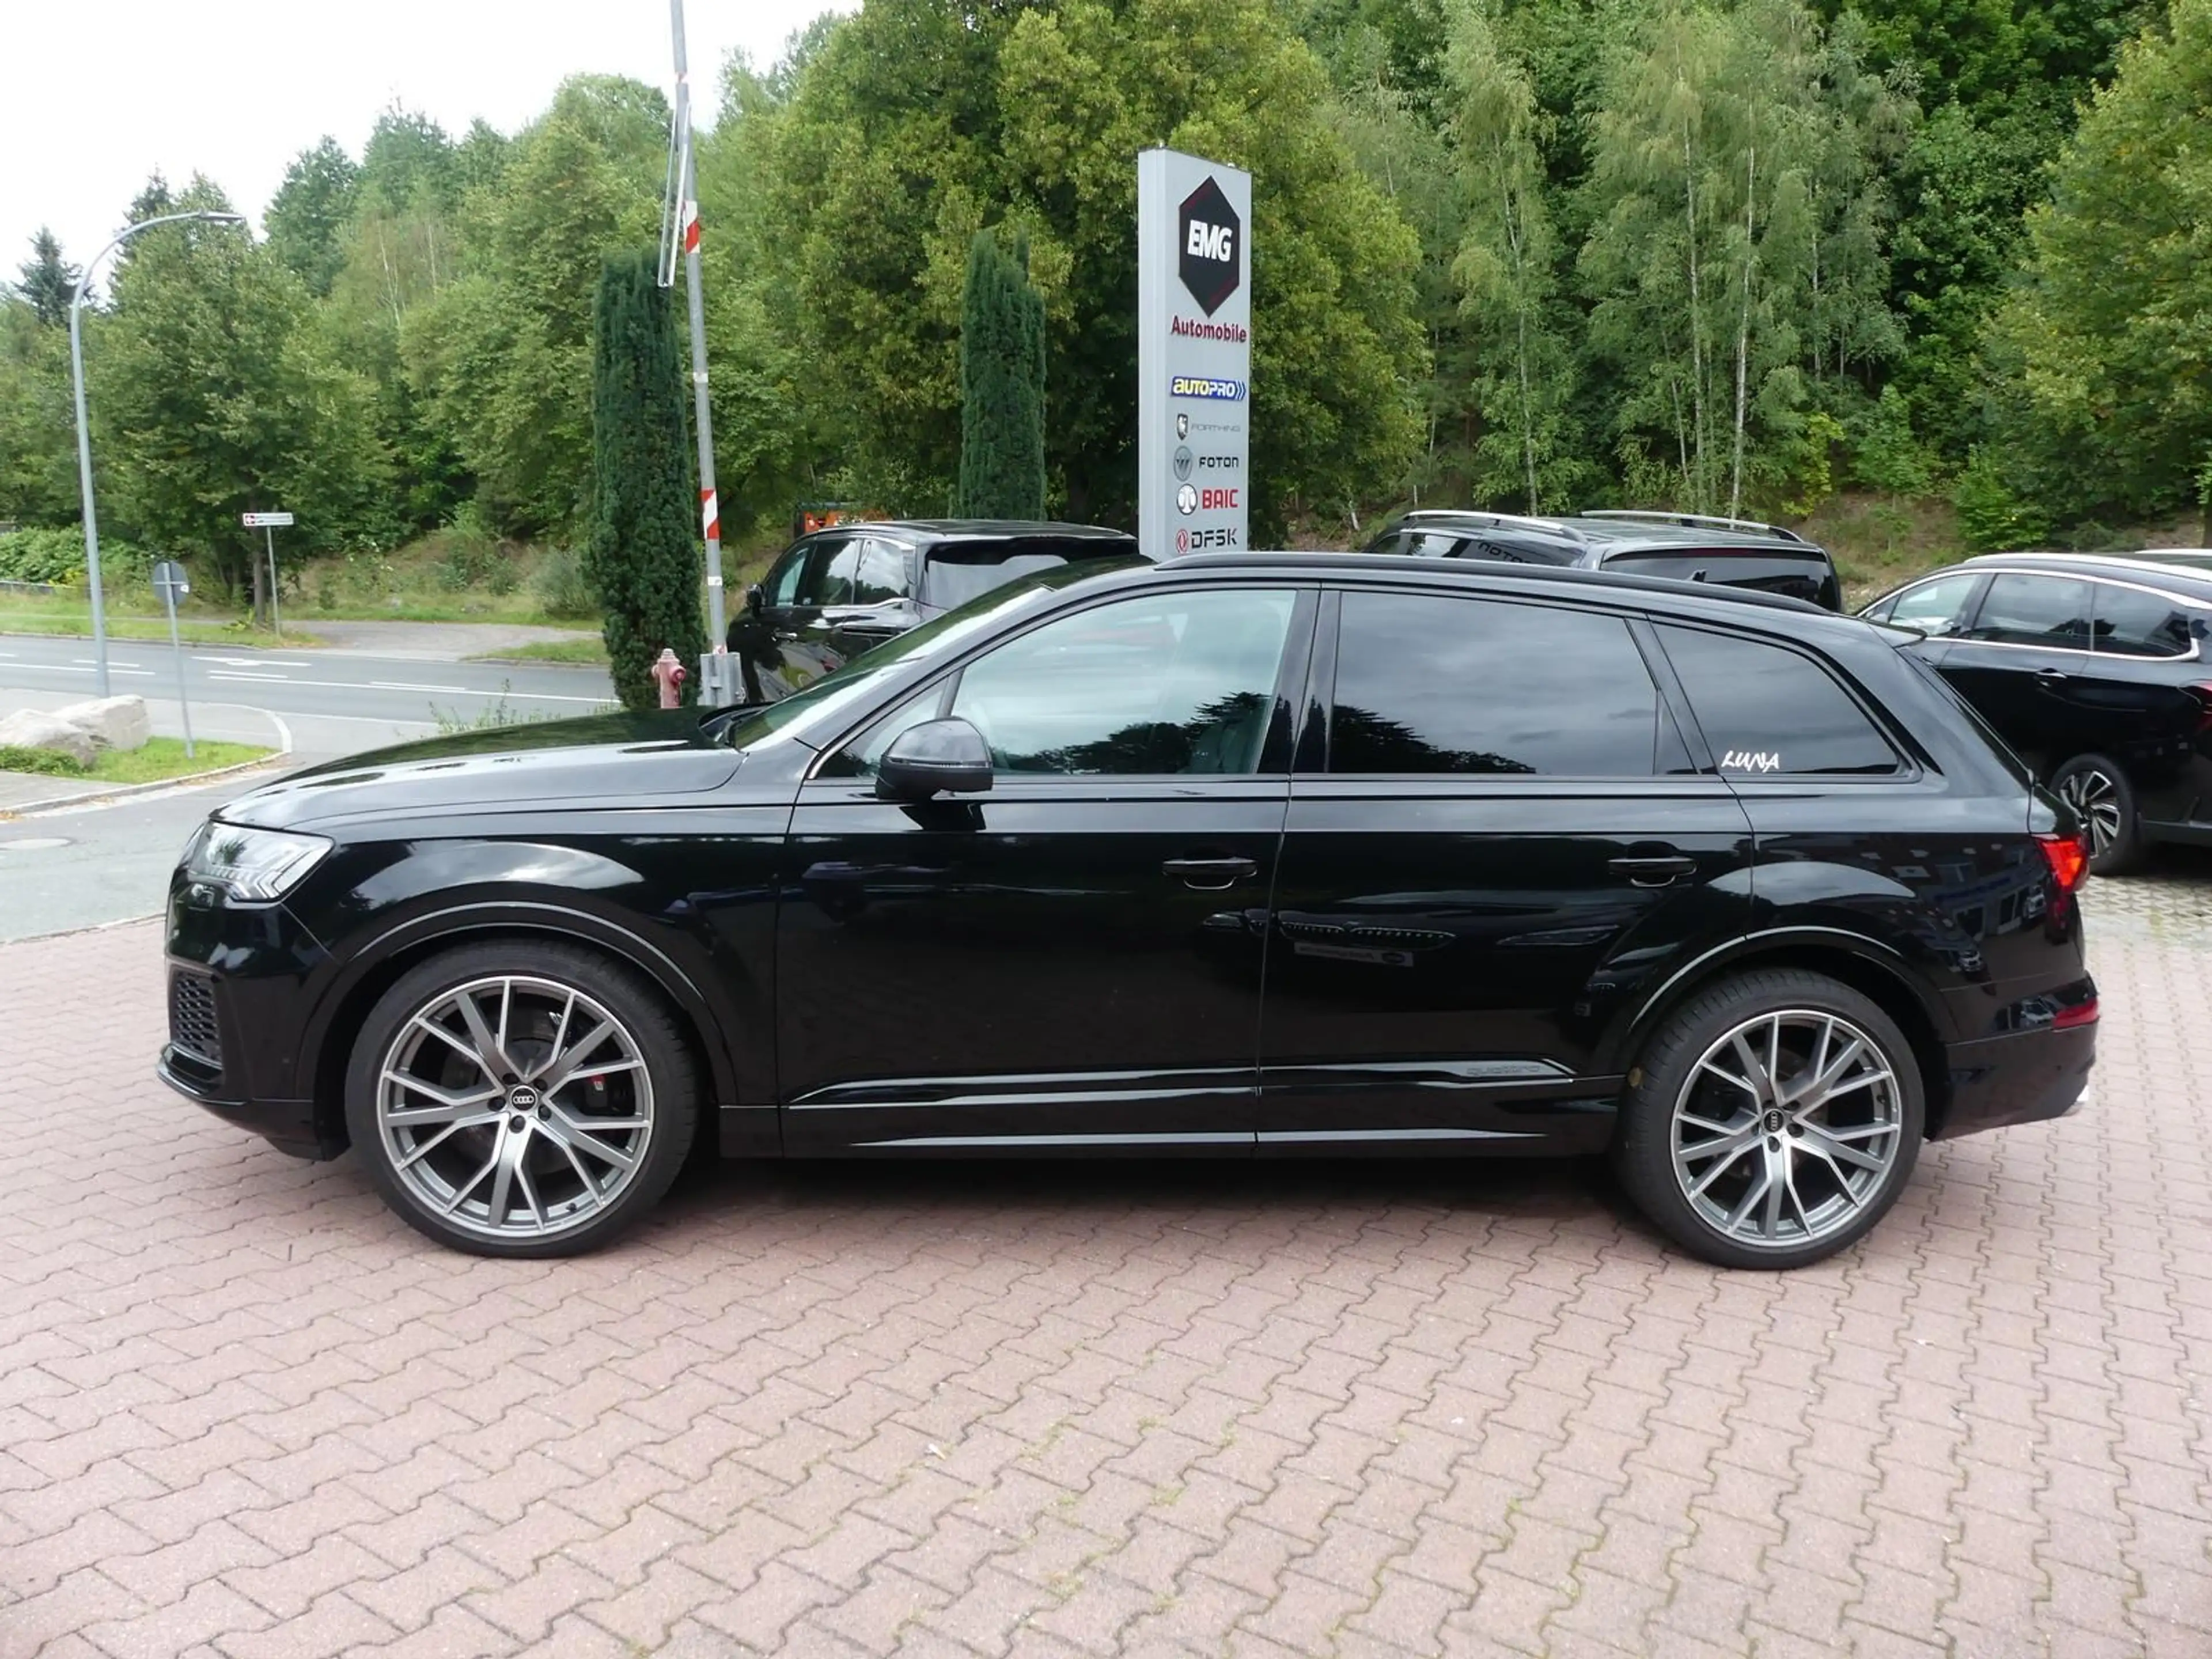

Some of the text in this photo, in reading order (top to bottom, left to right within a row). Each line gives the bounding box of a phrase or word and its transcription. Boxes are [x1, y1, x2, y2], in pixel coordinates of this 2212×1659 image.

[1188, 219, 1233, 262] EMG
[1171, 316, 1247, 343] Automobile
[1199, 457, 1238, 468] FOTON
[1202, 489, 1238, 509] BAIC
[1191, 529, 1238, 548] DFSK
[1721, 750, 1779, 773] LUNA
